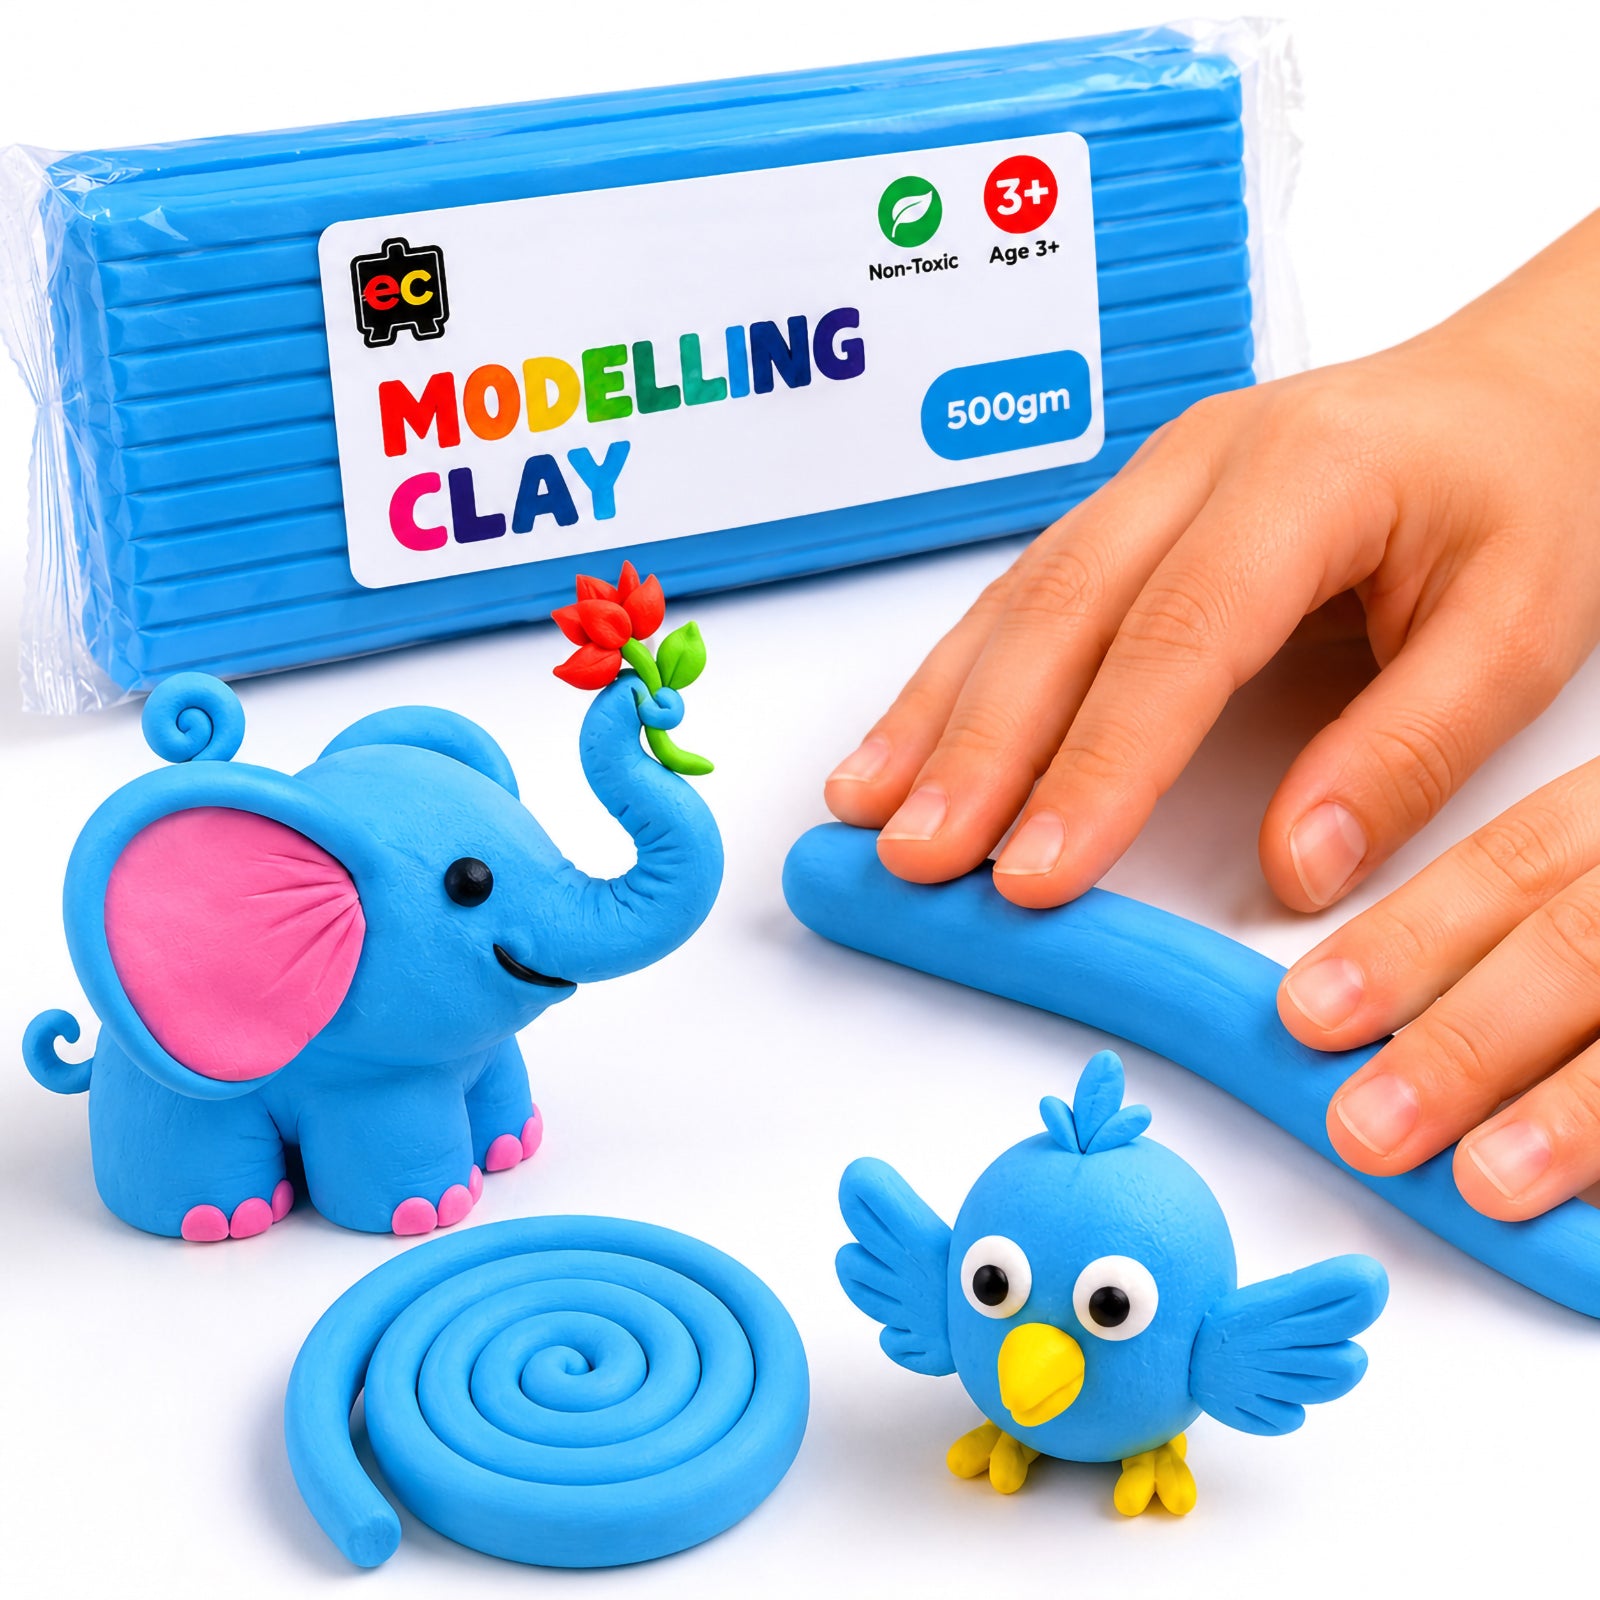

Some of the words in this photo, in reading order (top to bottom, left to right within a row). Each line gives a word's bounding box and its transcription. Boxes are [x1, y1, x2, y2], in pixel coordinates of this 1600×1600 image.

[995, 177, 1049, 216] 3+
[868, 253, 959, 281] Non-Toxic
[989, 246, 1029, 266] Age
[1035, 240, 1060, 257] 3+
[363, 269, 434, 311] ec
[378, 307, 866, 457] MODELLING
[947, 387, 1070, 430] 500gm
[388, 440, 631, 551] CLAY
